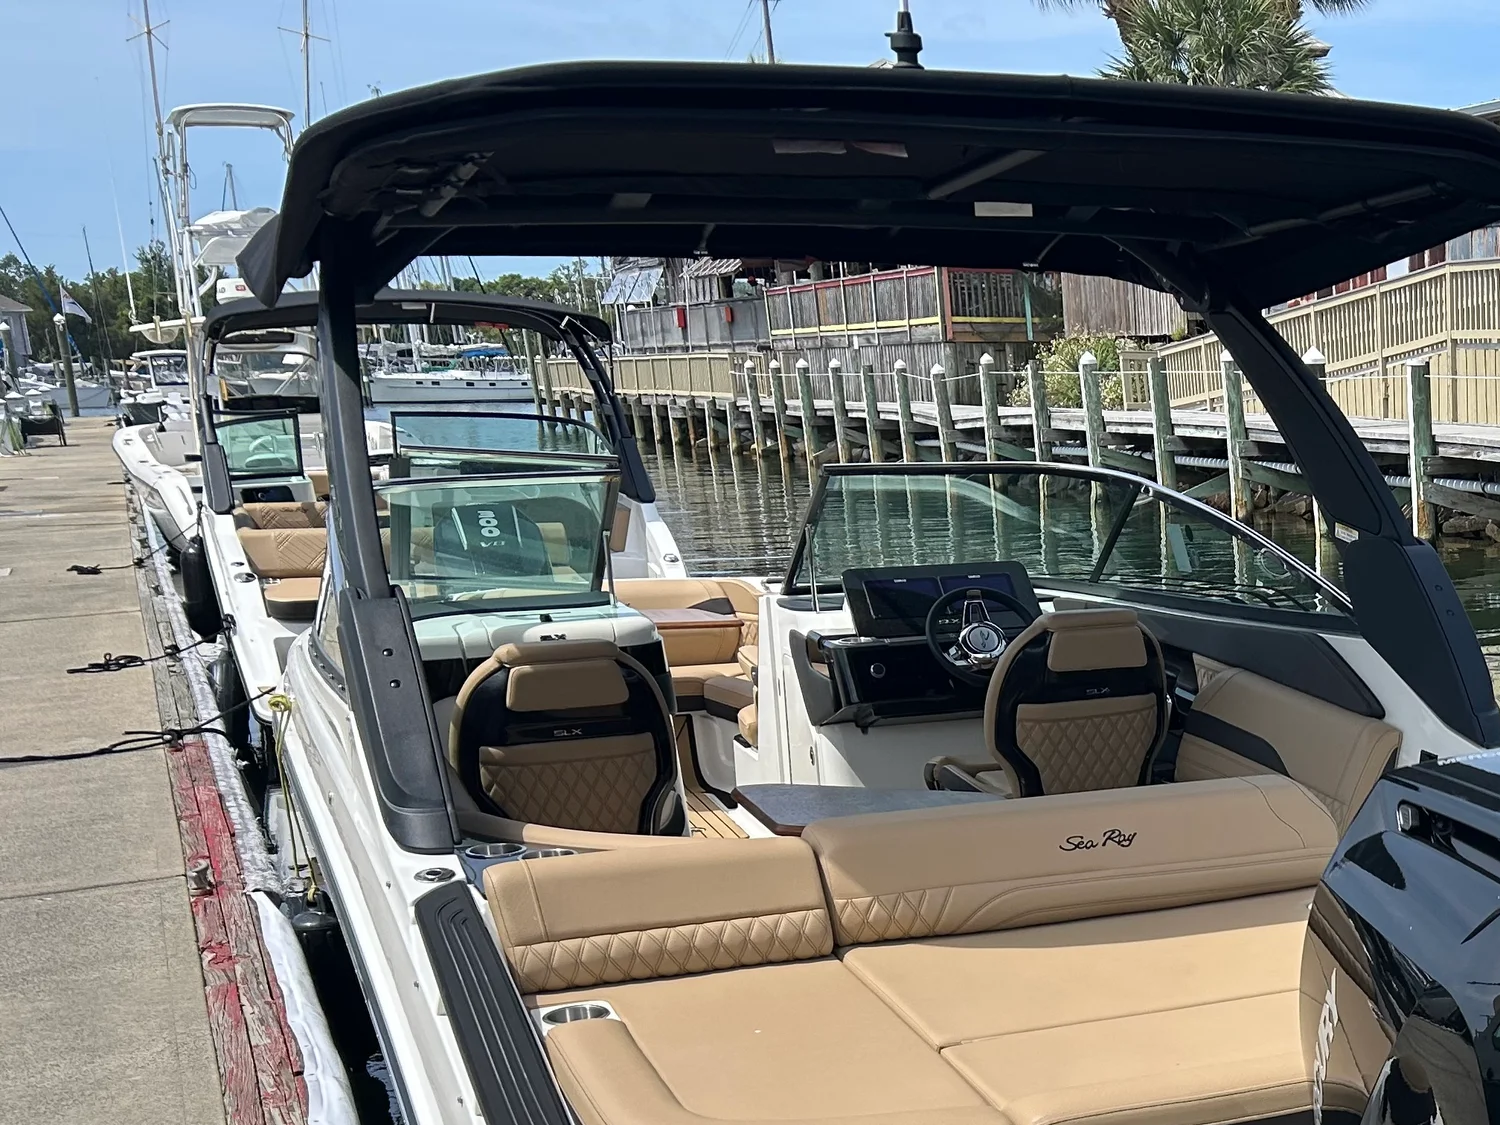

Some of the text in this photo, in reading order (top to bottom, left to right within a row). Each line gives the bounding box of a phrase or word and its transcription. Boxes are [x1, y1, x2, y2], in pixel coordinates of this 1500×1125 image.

[477, 510, 501, 537] 300
[553, 728, 582, 737] SLX
[1058, 828, 1138, 852] Sea Ray
